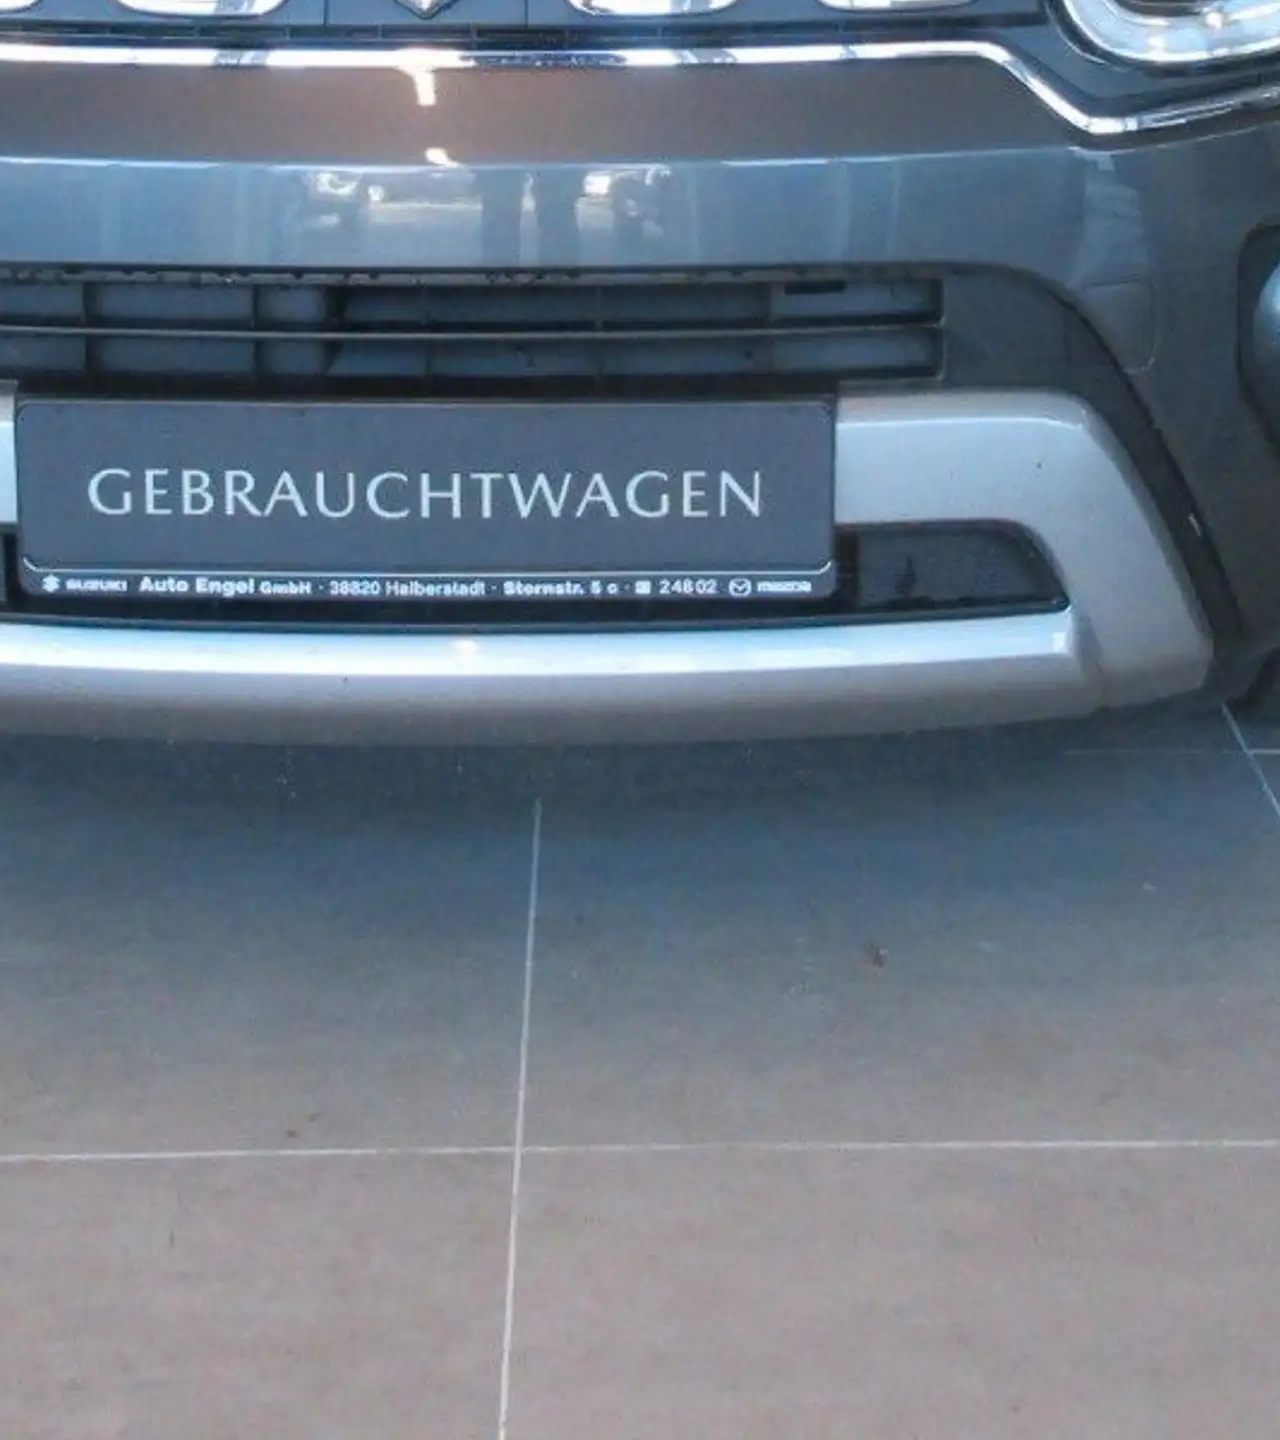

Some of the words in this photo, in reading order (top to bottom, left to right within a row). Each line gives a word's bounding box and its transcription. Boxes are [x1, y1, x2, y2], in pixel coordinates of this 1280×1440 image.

[87, 467, 762, 519] GEBRAUCHTWAGEN
[139, 576, 189, 593] Auto
[196, 576, 254, 598] Engel
[260, 580, 312, 595] GmbH
[330, 579, 381, 597] 38820
[386, 578, 485, 597] Halberstadt
